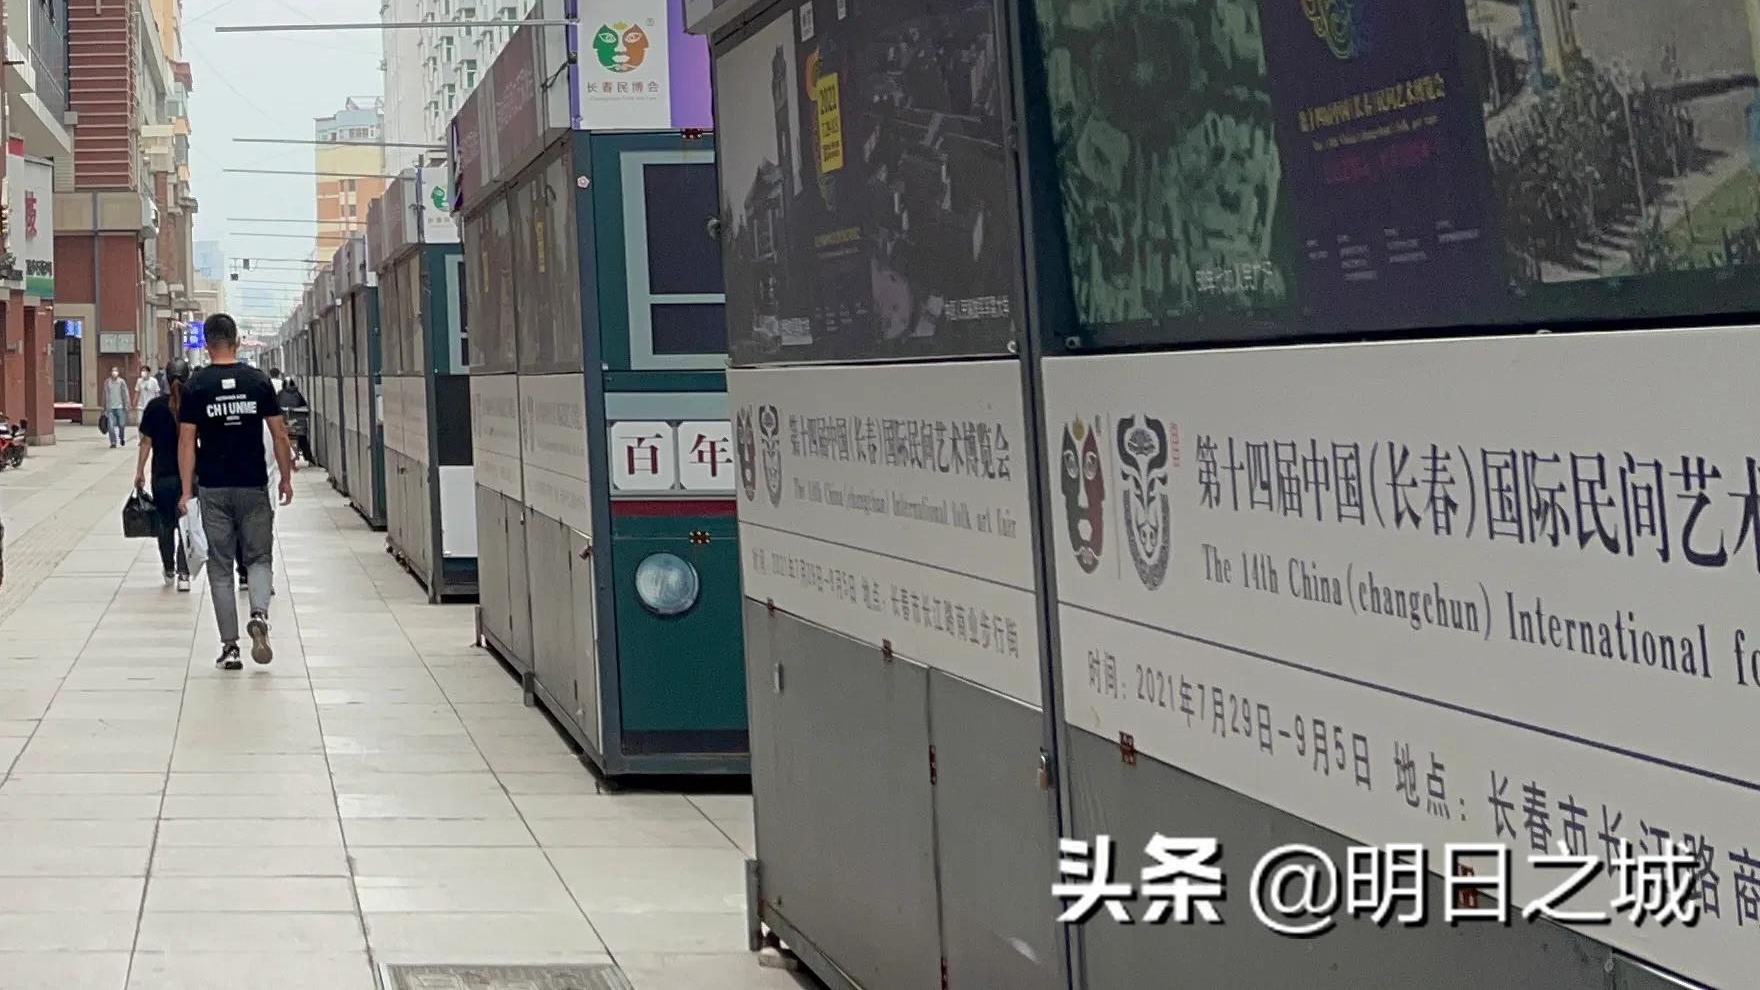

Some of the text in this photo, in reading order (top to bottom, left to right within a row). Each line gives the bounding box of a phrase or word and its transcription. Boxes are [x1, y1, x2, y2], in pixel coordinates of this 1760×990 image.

[619, 433, 734, 477] 百年
[1201, 543, 1232, 584] The
[1242, 552, 1279, 595] 14th
[1507, 590, 1712, 679] International
